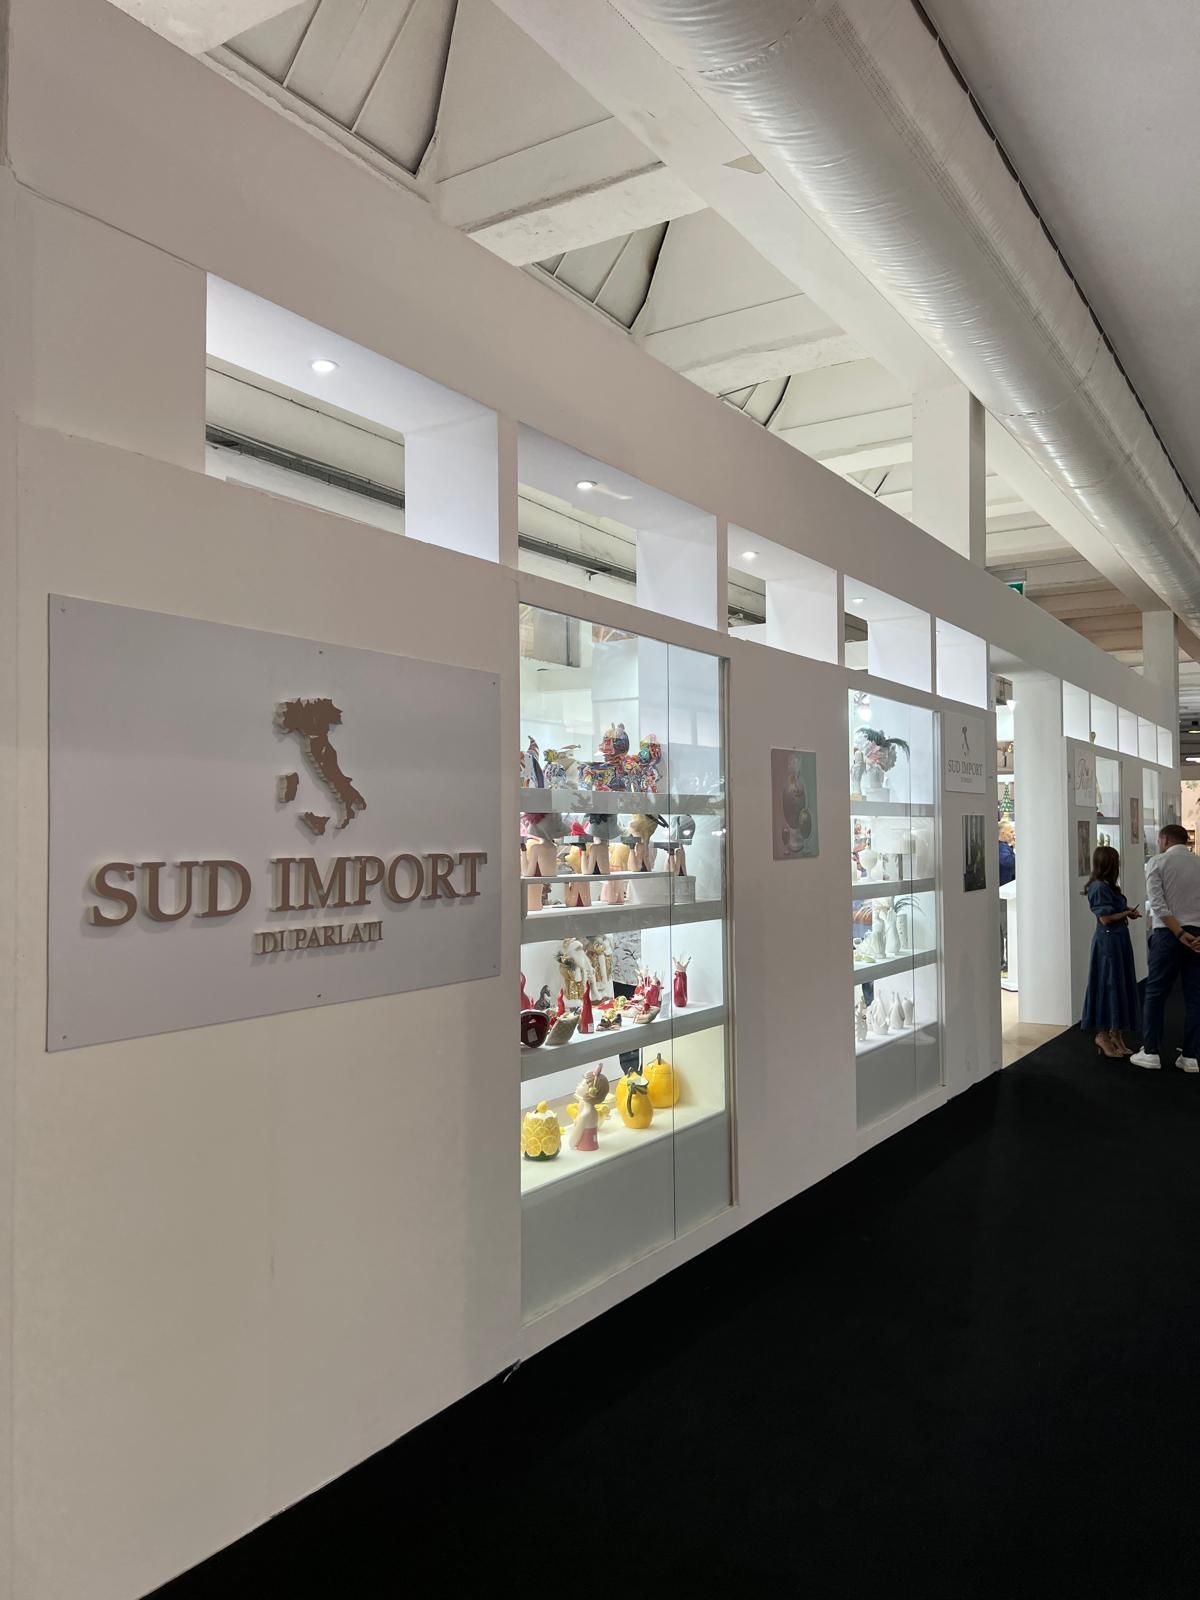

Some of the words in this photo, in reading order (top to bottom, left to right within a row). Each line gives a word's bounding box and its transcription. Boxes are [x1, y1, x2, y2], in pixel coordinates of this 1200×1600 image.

[947, 759, 961, 774] SUD
[961, 761, 983, 776] IMPORT
[89, 859, 252, 927] SUD
[270, 852, 488, 912] IMPORT
[255, 929, 286, 955] DI
[291, 921, 384, 951] PARLATI
